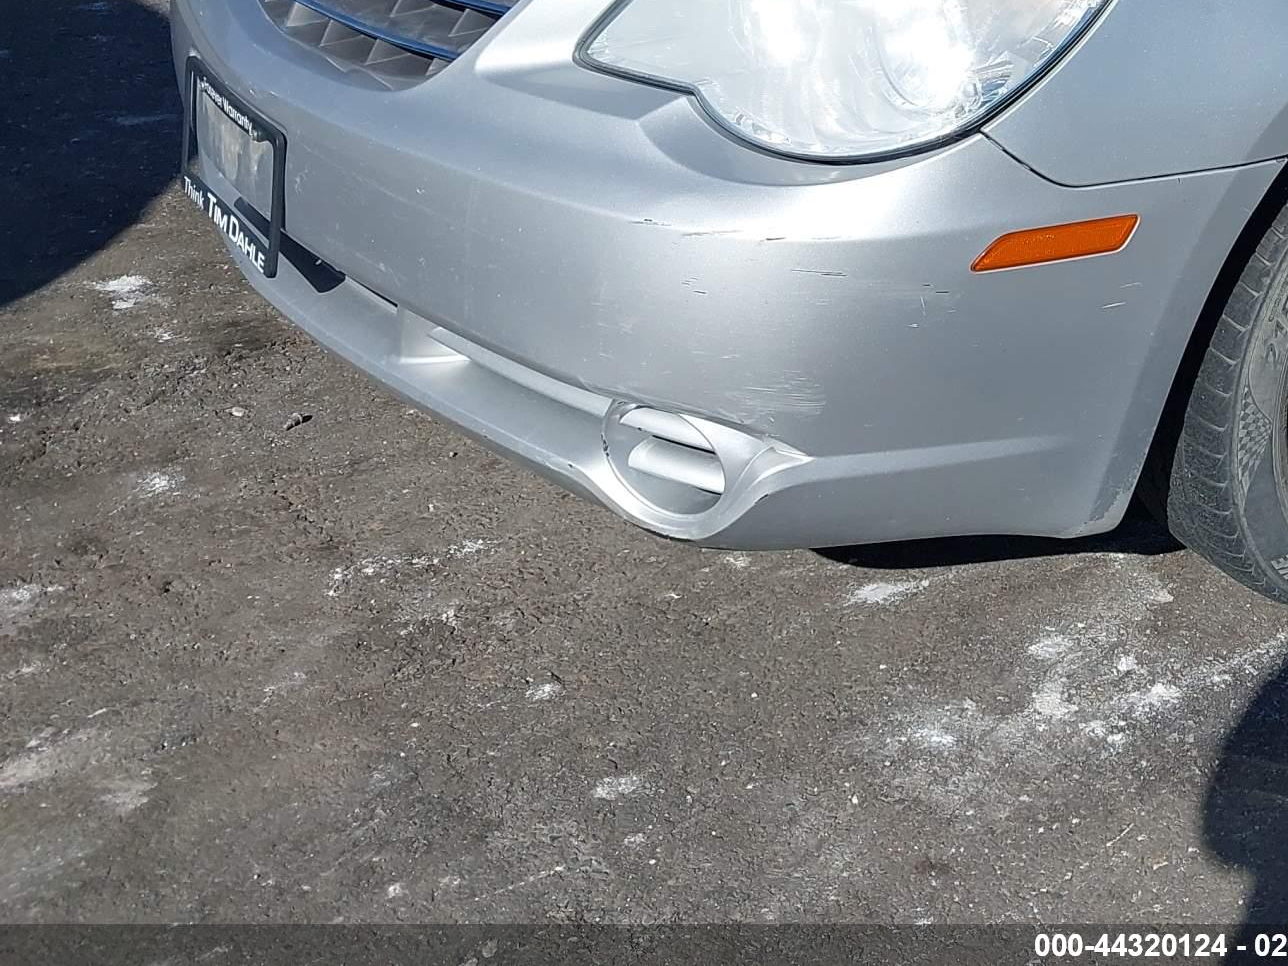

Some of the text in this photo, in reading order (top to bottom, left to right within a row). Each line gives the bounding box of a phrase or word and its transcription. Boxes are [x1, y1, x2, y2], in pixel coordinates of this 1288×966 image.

[222, 96, 254, 136] Warranty
[183, 175, 266, 274] Think TIM DAHLE
